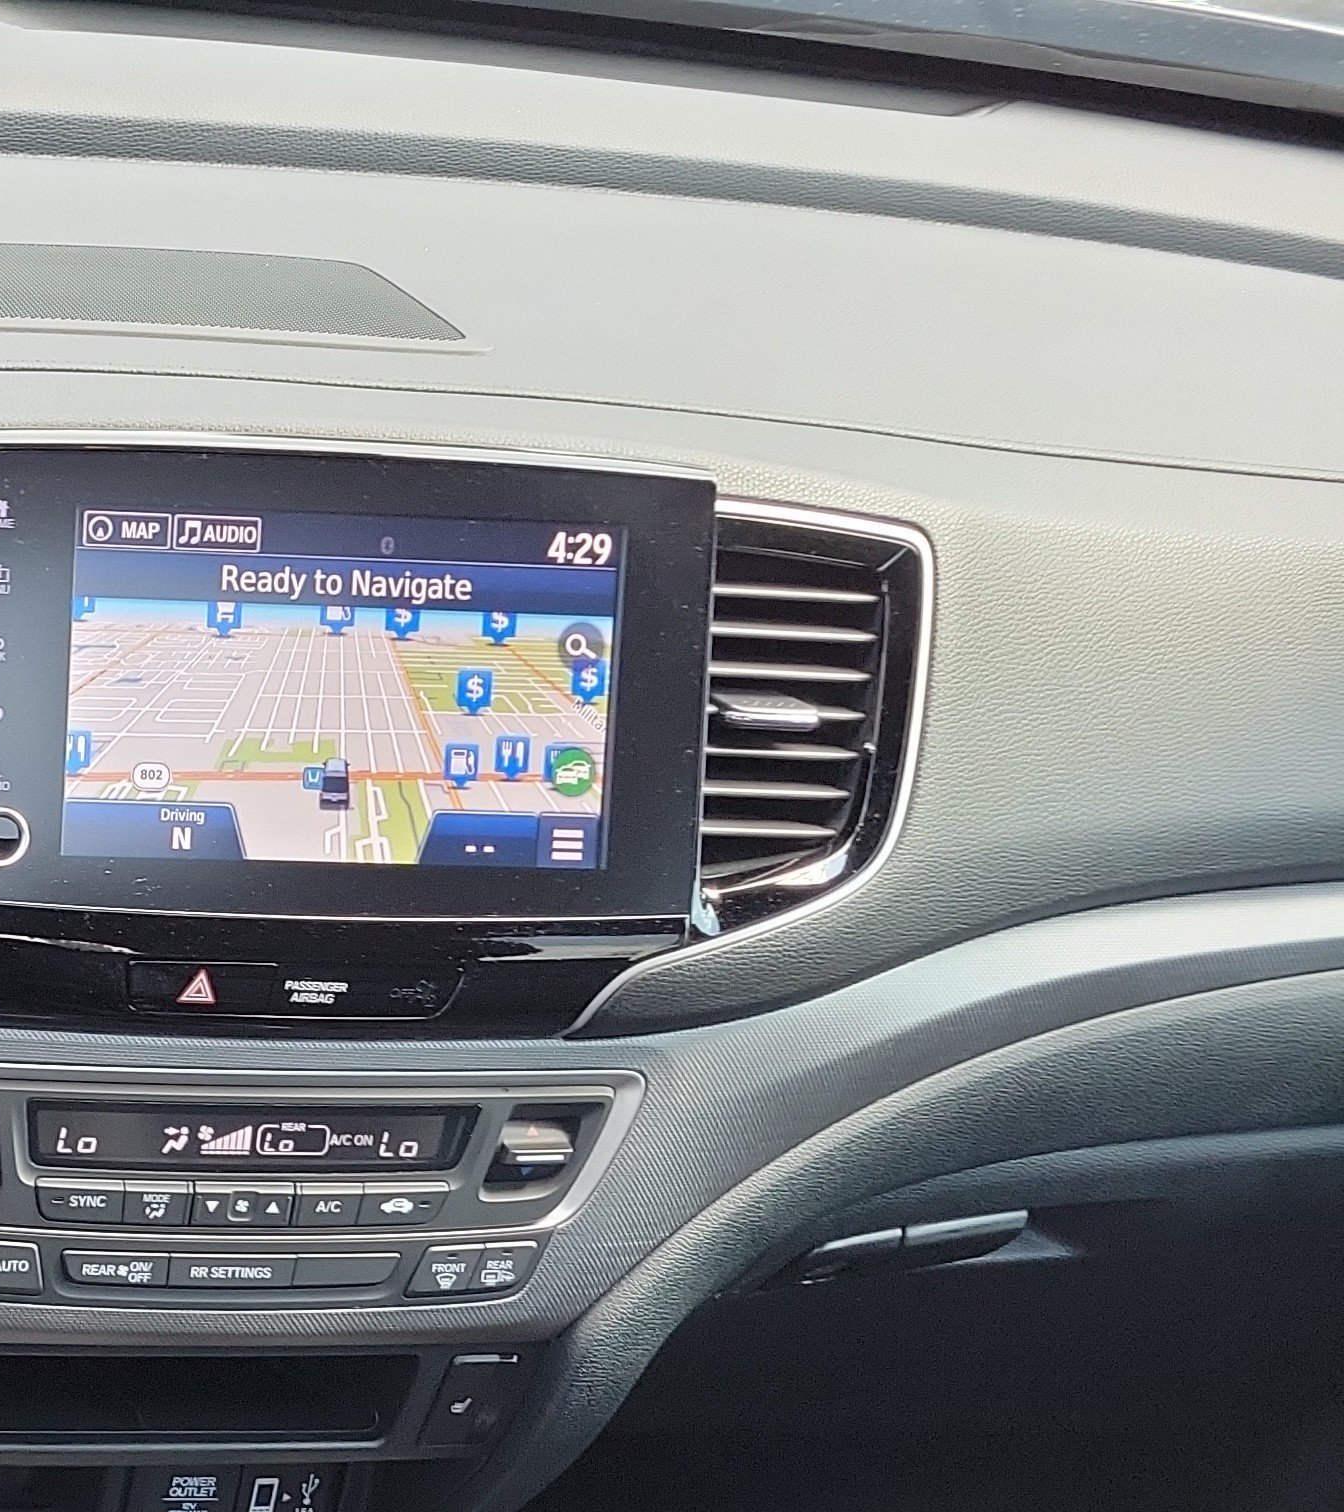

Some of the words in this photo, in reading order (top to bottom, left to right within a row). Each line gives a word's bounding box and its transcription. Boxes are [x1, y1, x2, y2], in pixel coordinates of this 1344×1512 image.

[121, 521, 160, 540] MAP
[203, 525, 258, 544] AUDIO
[547, 530, 612, 565] 4:29
[221, 564, 307, 600] Ready
[314, 570, 342, 596] to
[351, 570, 472, 605] Navigate
[140, 769, 163, 781] 802
[160, 808, 205, 825] Driving
[172, 827, 192, 850] N
[284, 980, 349, 993] PASSENGER
[289, 992, 336, 1004] AIRBAG
[280, 1122, 307, 1132] REAR
[56, 1126, 98, 1154] Lo
[263, 1132, 294, 1152] Lo
[329, 1133, 353, 1148] A/C
[354, 1134, 374, 1148] ON
[378, 1130, 418, 1158] Lo
[69, 1195, 108, 1209] SYNC
[143, 1193, 171, 1203] MODE
[315, 1200, 342, 1214] A/C
[81, 1263, 116, 1276] REAR
[130, 1261, 154, 1272] ON/
[432, 1263, 467, 1273] FRONT
[486, 1260, 514, 1270] REAR
[127, 1272, 152, 1283] OFF
[189, 1266, 208, 1279] RR
[208, 1266, 272, 1280] SETTINGS
[171, 1476, 217, 1487] POWER
[168, 1487, 217, 1498] OUTLET
